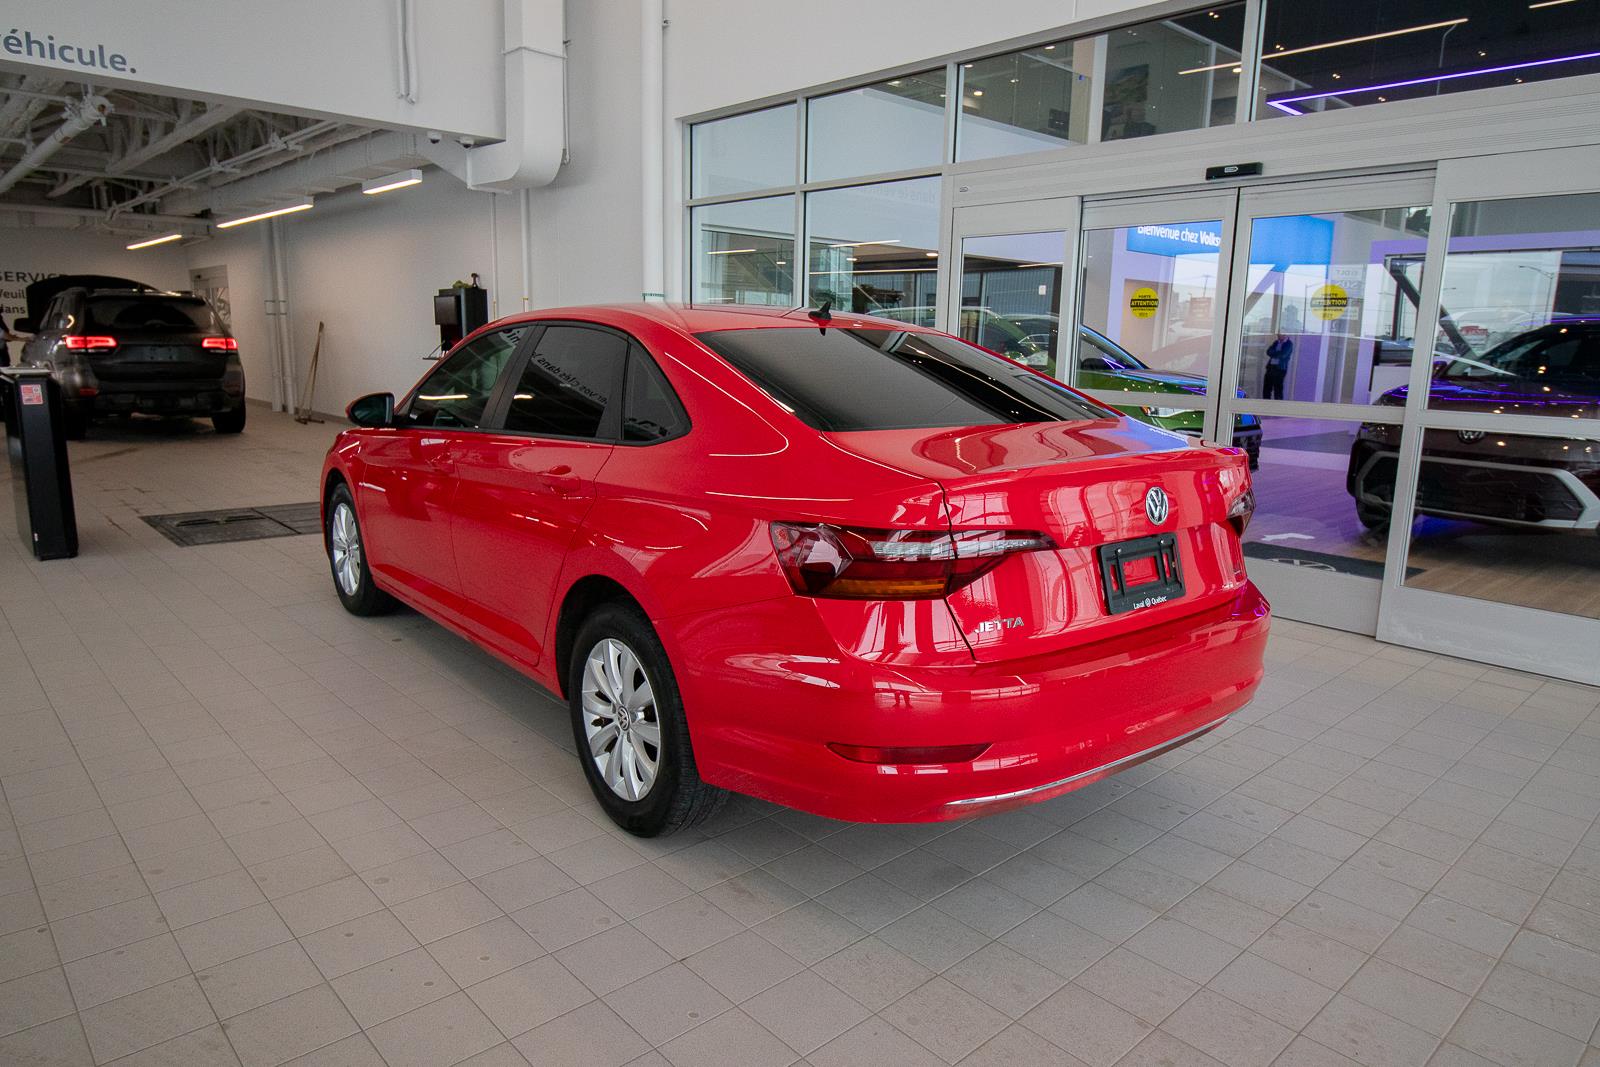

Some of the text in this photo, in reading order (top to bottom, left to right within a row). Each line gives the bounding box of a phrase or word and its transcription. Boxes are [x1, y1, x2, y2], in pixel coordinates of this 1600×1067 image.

[0, 28, 137, 74] éhicule.
[1180, 228, 1199, 243] chez
[0, 271, 57, 283] ERVI
[974, 617, 1025, 633] JETTA
